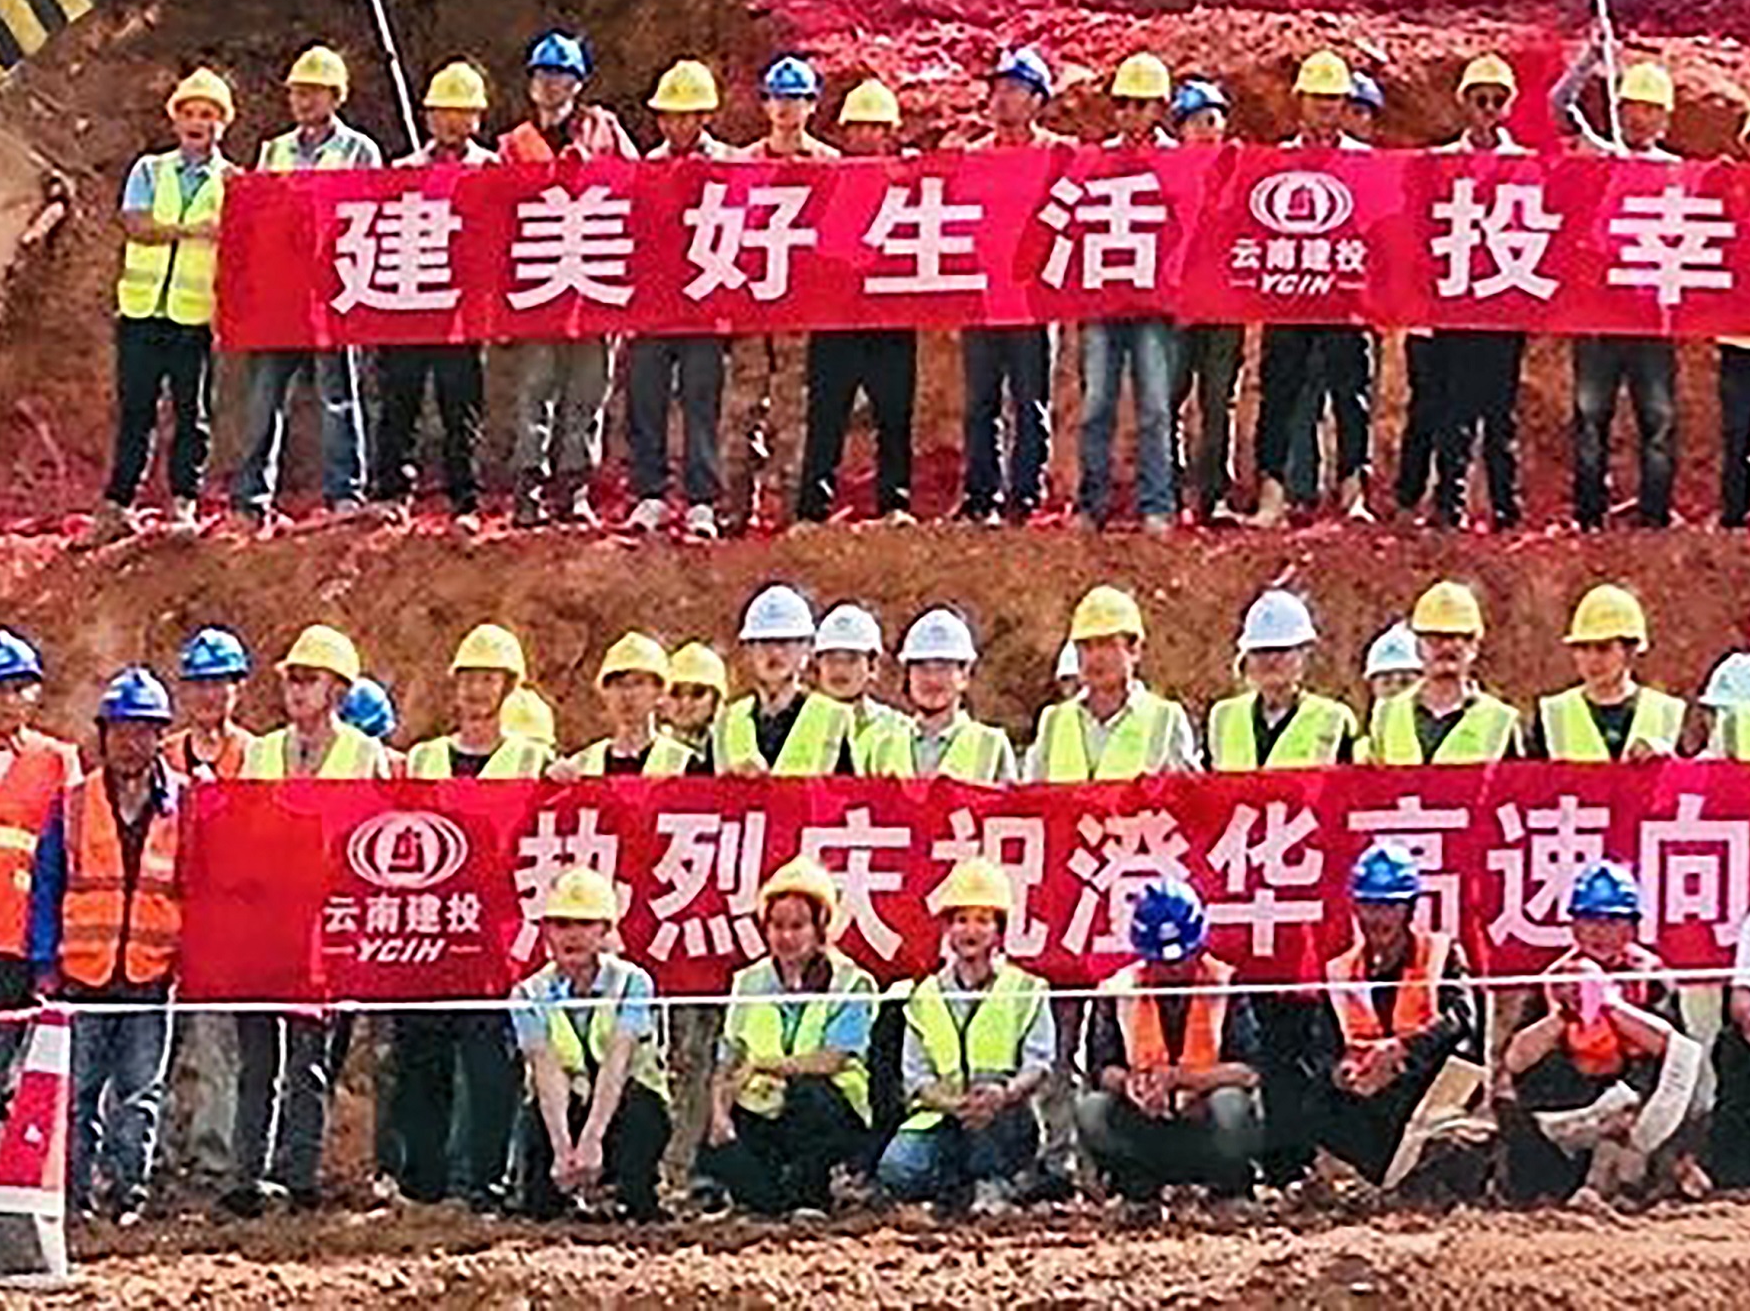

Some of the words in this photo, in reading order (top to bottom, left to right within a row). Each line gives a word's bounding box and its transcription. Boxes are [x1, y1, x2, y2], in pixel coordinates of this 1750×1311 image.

[330, 172, 1168, 316] 建美好生活
[1230, 238, 1369, 273] 云南建投
[322, 892, 481, 934] 云南建投
[357, 938, 446, 963] YCIH
